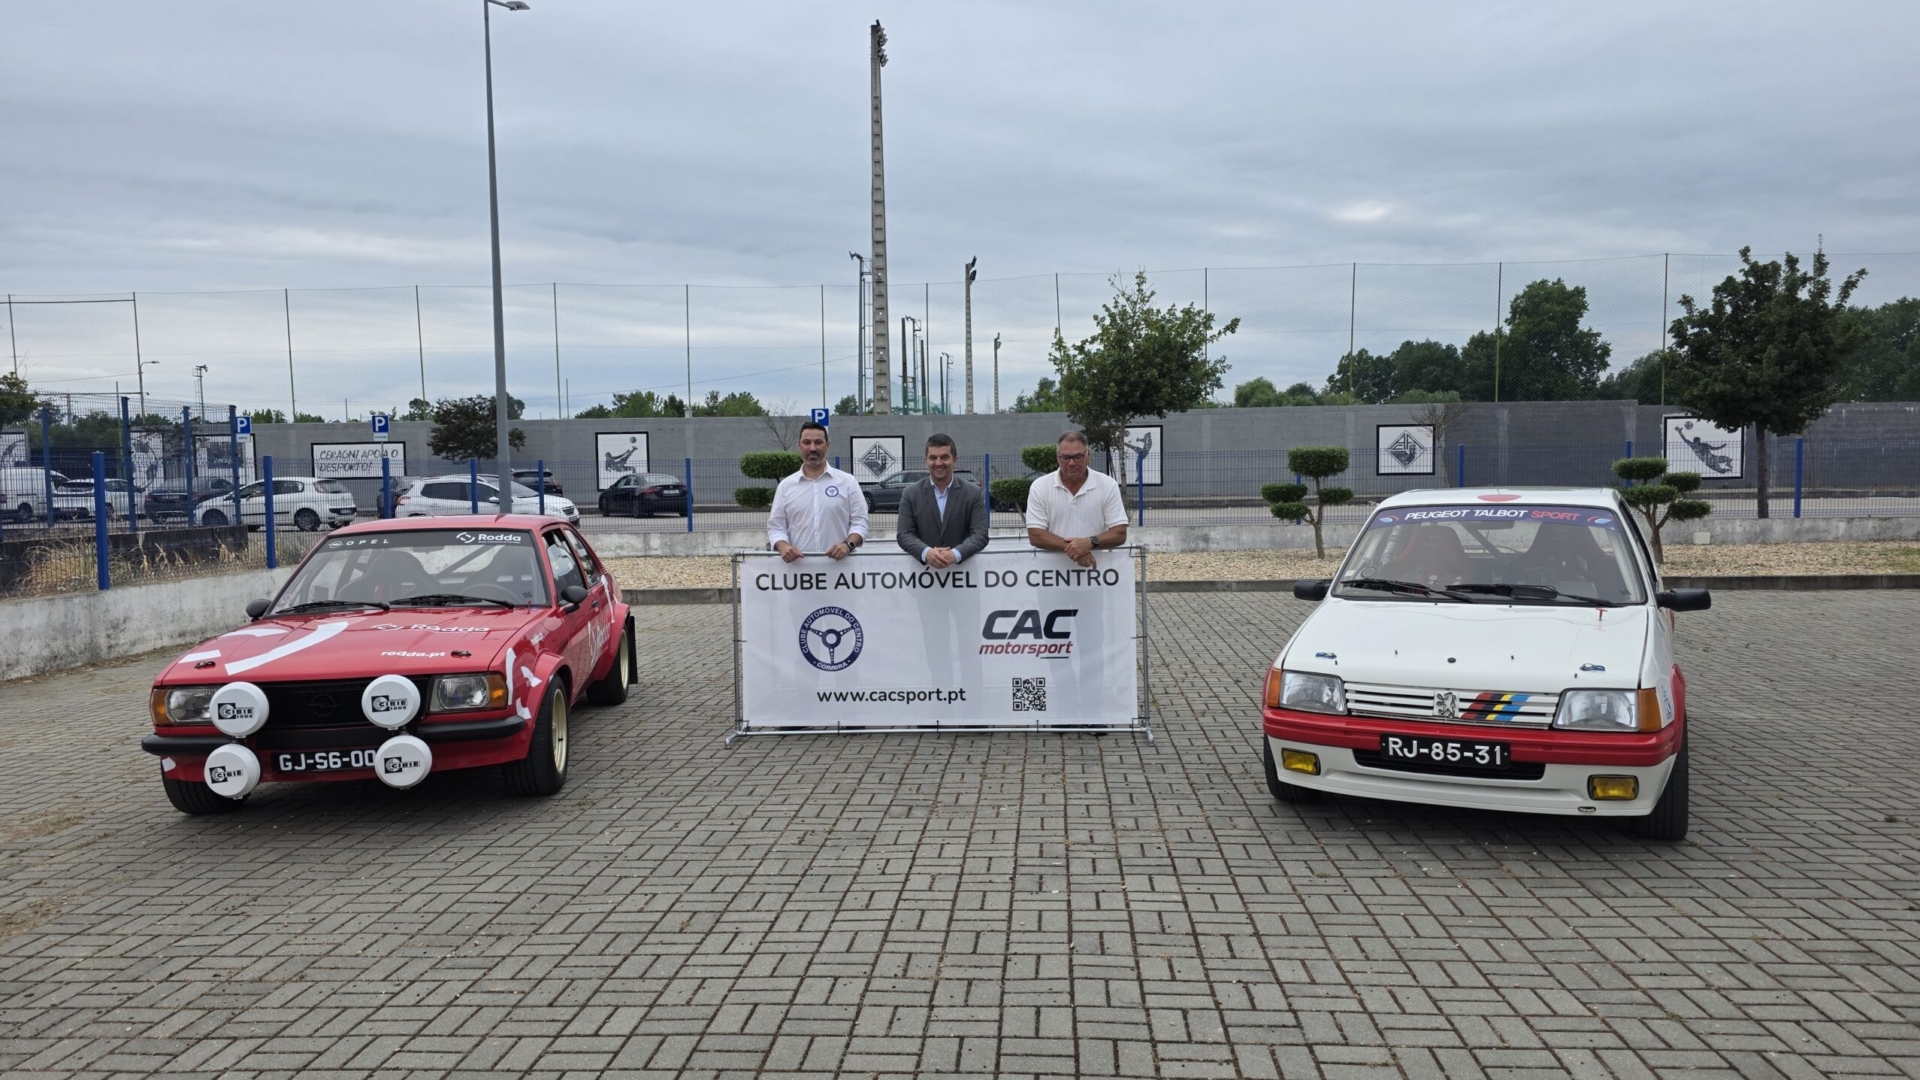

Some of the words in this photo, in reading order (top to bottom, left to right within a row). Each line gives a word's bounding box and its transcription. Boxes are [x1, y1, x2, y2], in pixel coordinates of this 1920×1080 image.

[374, 416, 386, 432] P
[815, 409, 826, 423] P
[236, 417, 248, 433] P
[390, 448, 399, 459] O
[1404, 509, 1470, 521] PEUGEOT
[1473, 509, 1529, 518] TALBOT
[1531, 510, 1581, 521] SPORT
[345, 538, 390, 546] OPEL
[478, 533, 522, 542] Rodda
[755, 573, 828, 591] CLUBE
[834, 566, 978, 590] AUTOMÓVEL
[984, 570, 1018, 588] DO
[1026, 568, 1120, 587] CENTRO
[410, 623, 490, 633] Rodda
[982, 609, 1079, 640] CAC
[800, 628, 809, 654] CLUBE
[844, 612, 855, 623] DO
[853, 622, 862, 653] CENTRO
[381, 650, 446, 658] rodda.pt
[979, 641, 1073, 657] motorsport
[816, 688, 967, 704] www.cacsport.pt
[1388, 737, 1501, 765] RJ-85-31
